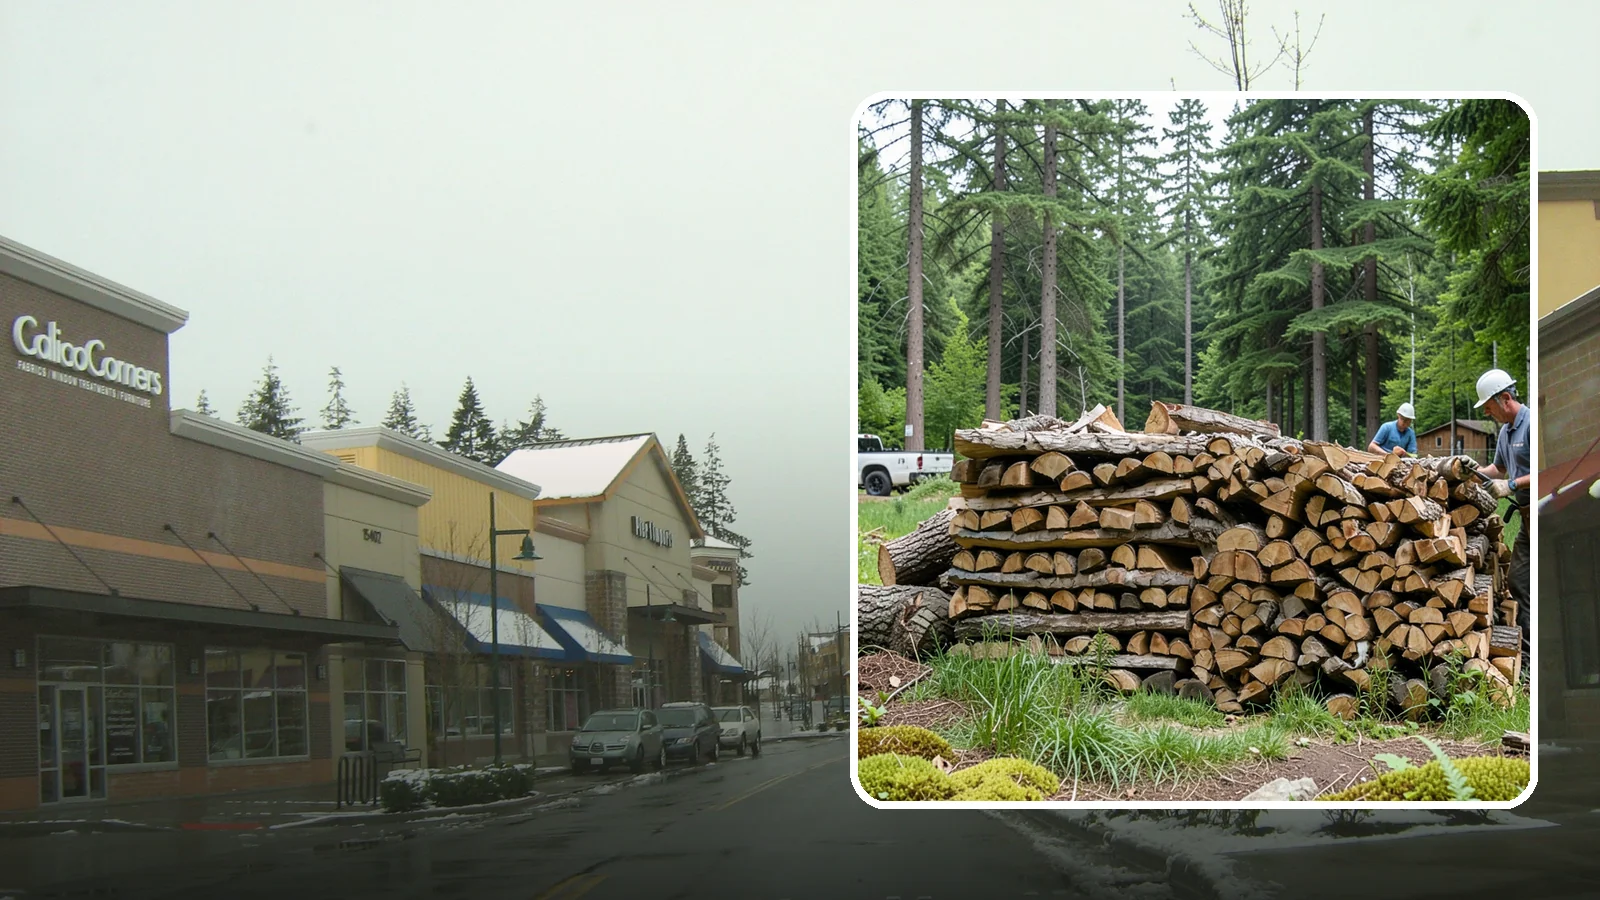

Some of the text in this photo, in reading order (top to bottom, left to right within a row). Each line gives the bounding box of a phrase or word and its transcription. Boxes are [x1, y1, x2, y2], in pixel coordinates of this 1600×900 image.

[12, 315, 162, 395] CalicoCorners
[17, 359, 151, 408] FABRICS WINDOW TREATMENTS FURNITURE
